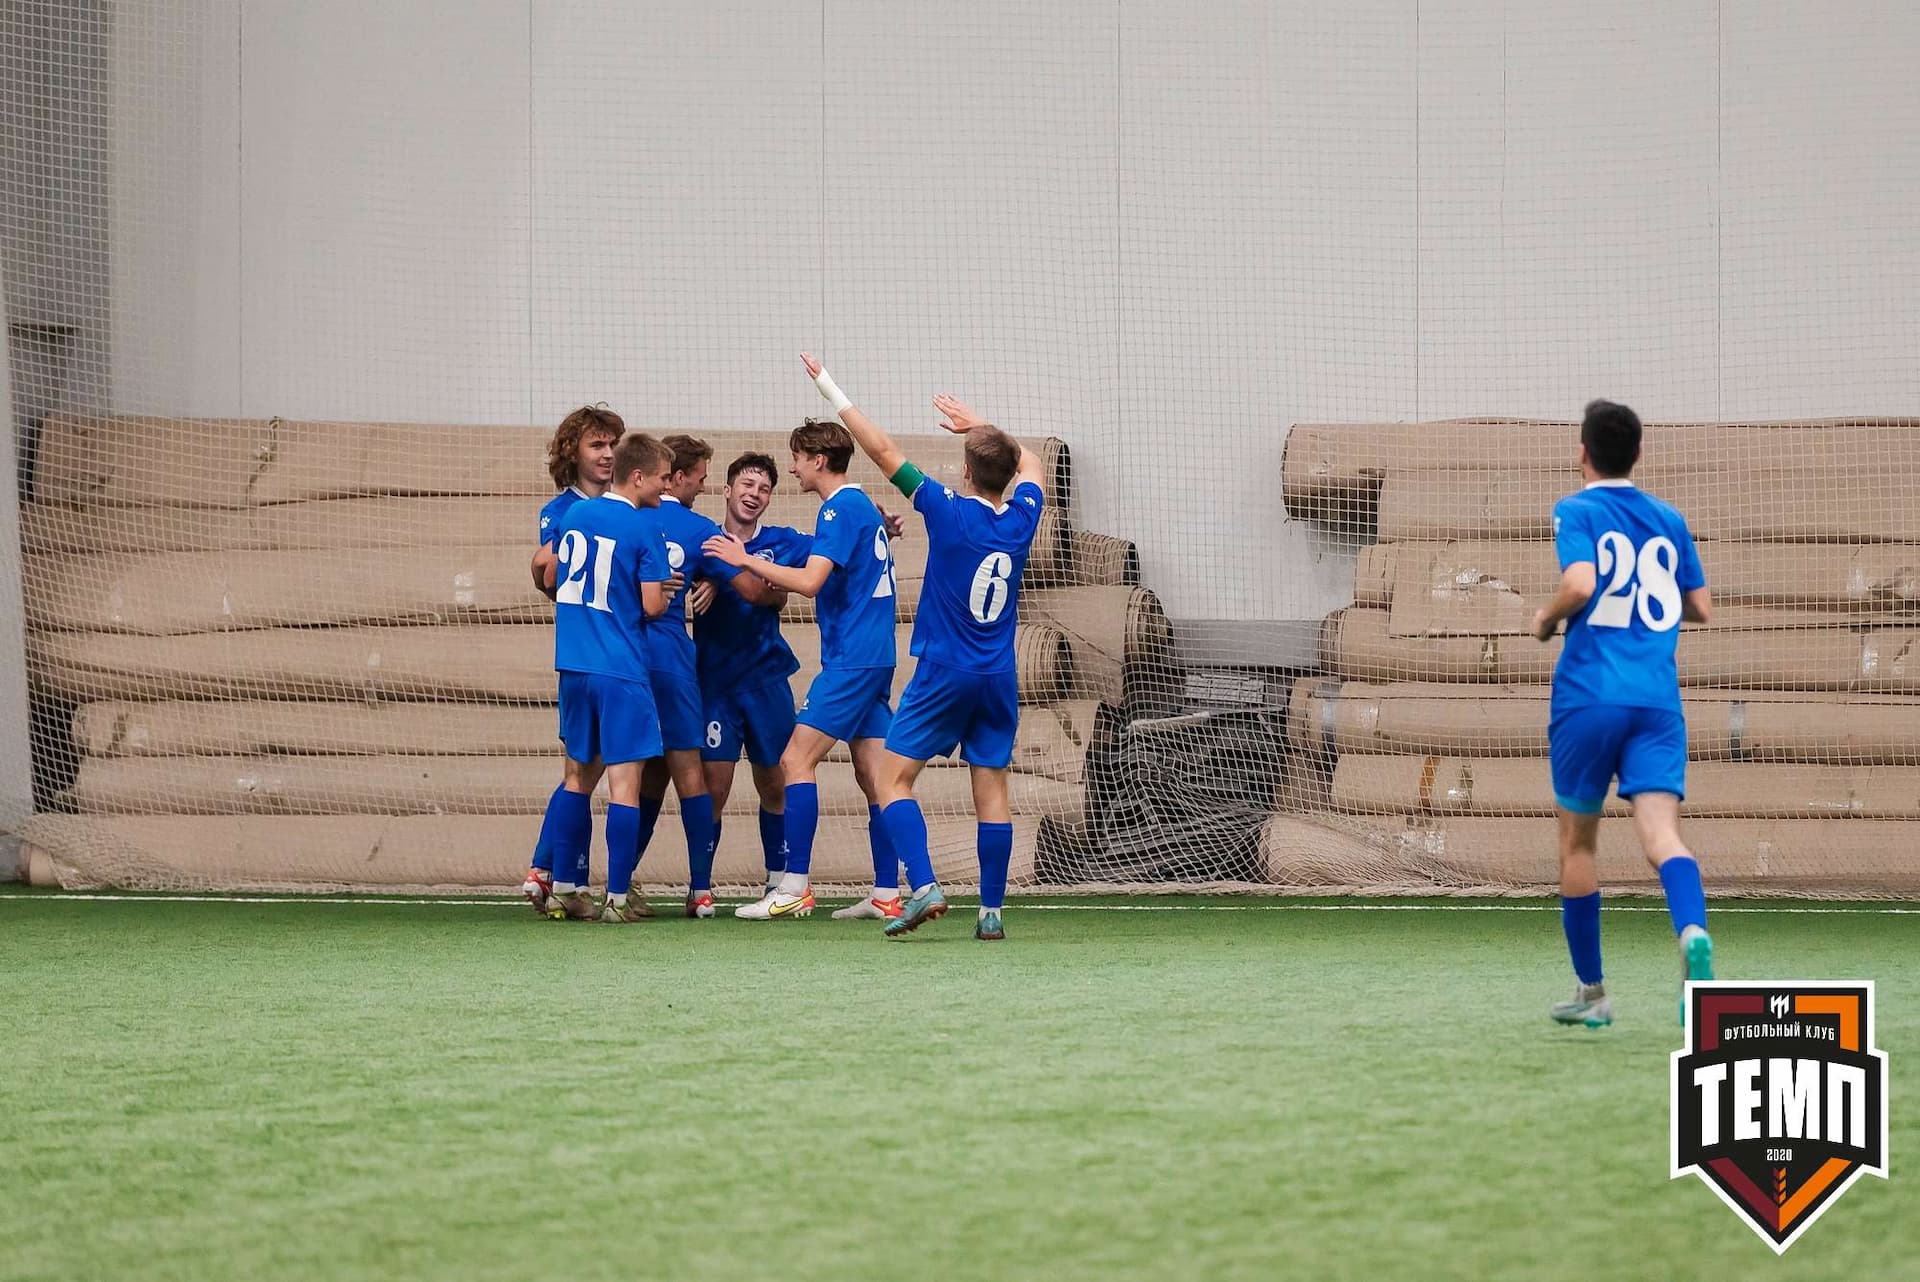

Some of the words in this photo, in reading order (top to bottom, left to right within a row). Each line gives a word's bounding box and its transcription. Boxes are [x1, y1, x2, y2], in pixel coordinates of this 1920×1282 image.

[556, 529, 616, 613] 21
[872, 525, 896, 598] 2
[970, 551, 1013, 624] 6
[1586, 530, 1683, 632] 28
[706, 720, 722, 748] 8
